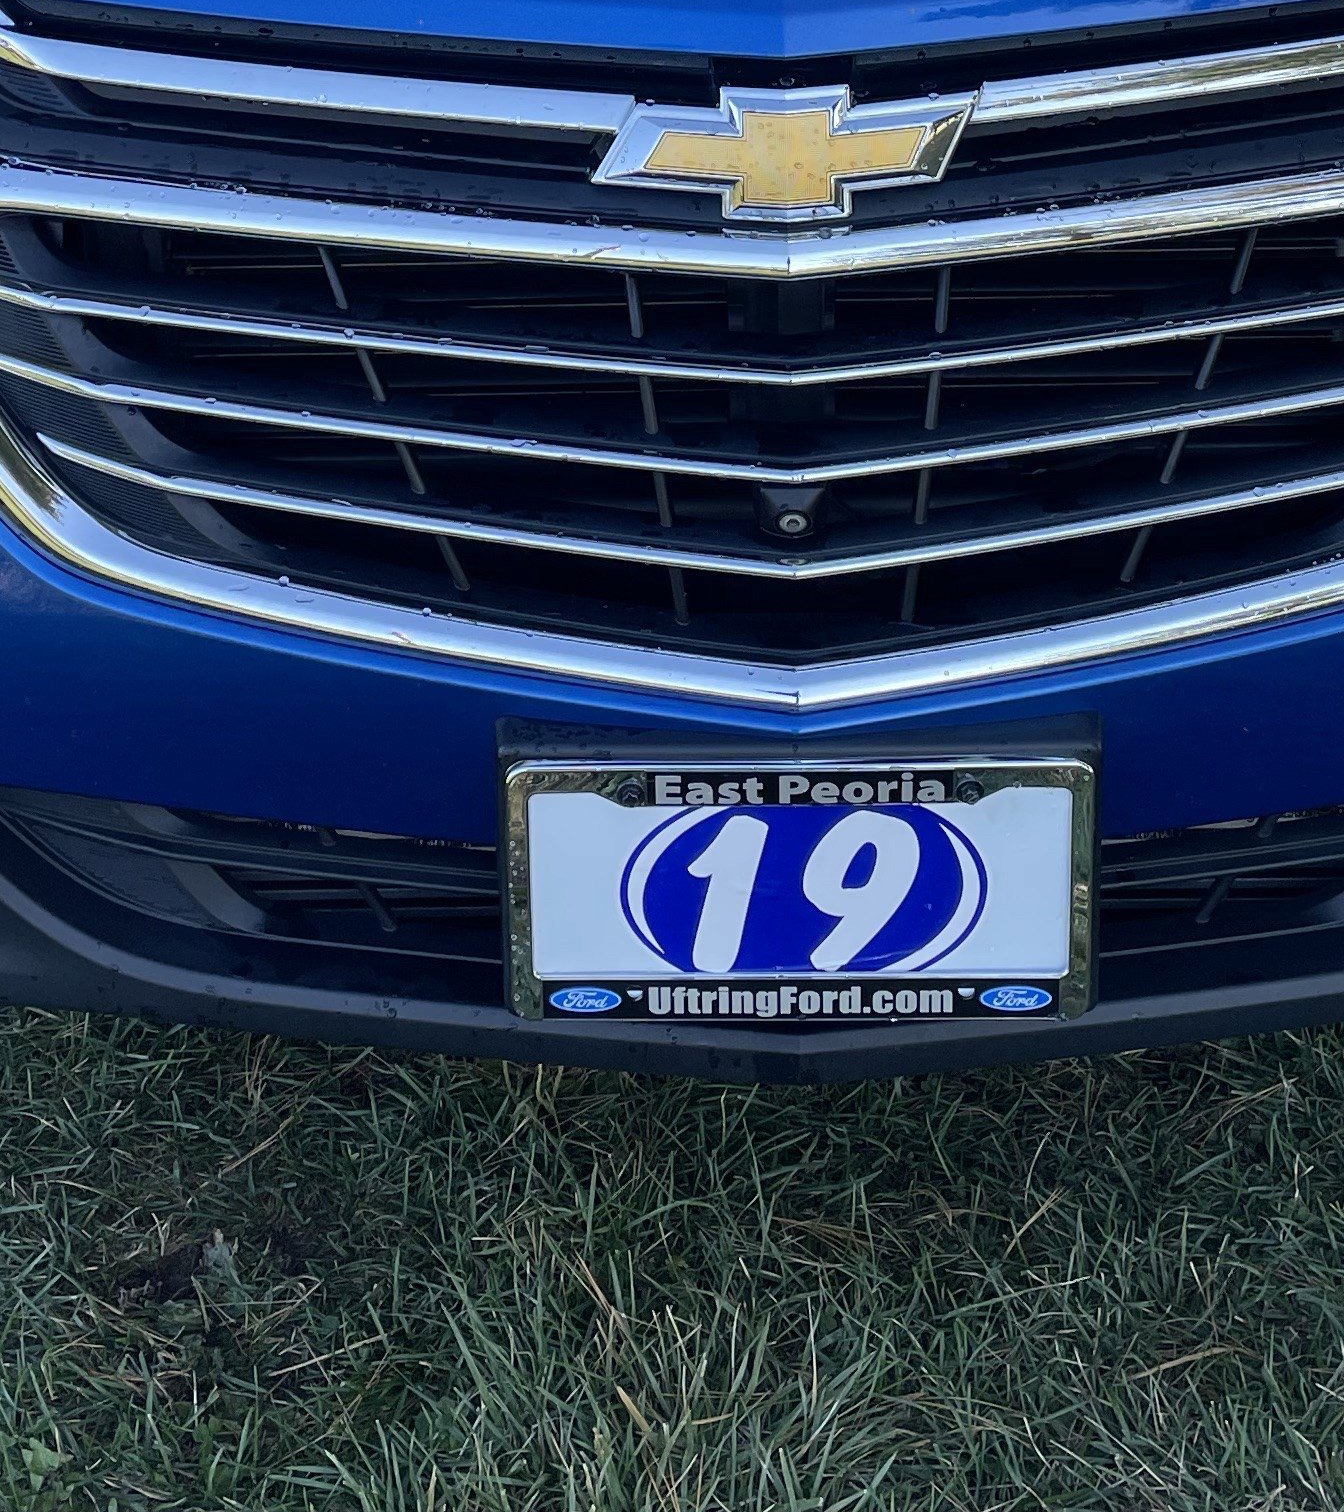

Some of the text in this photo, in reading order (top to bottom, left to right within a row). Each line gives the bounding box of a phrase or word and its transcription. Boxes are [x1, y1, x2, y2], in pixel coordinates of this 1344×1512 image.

[654, 772, 946, 805] East Peoria
[687, 810, 920, 973] 19
[562, 990, 609, 1009] Ford
[647, 985, 954, 1017] UftringFord.com
[992, 988, 1039, 1007] Ford
